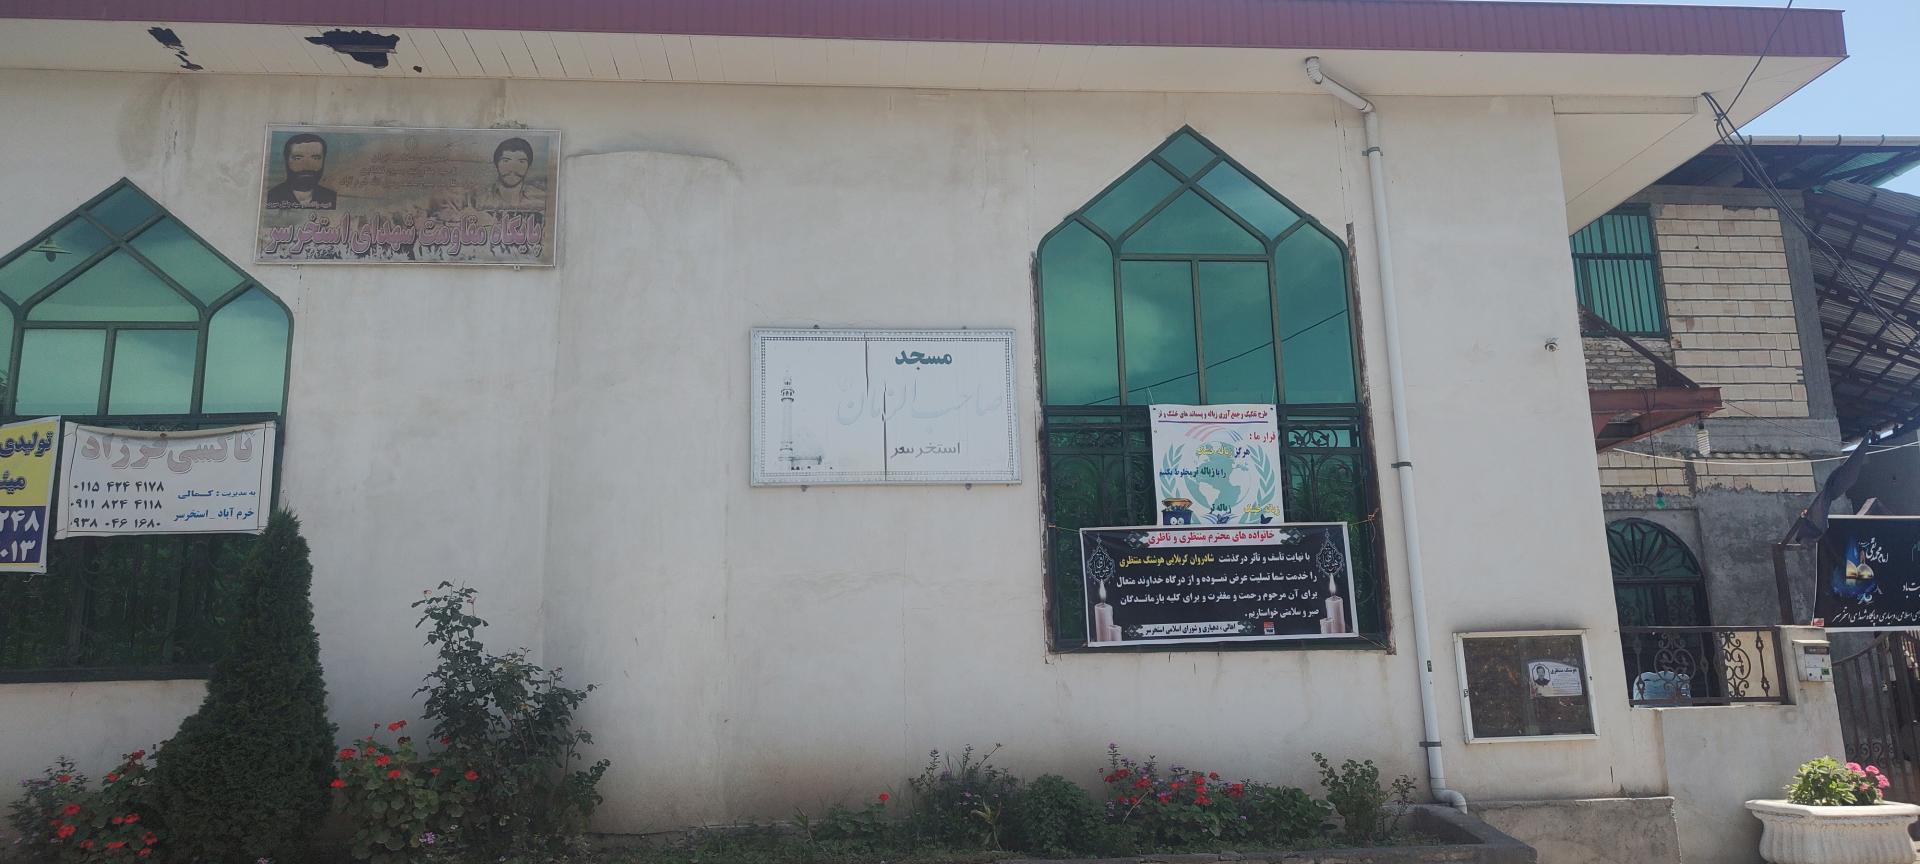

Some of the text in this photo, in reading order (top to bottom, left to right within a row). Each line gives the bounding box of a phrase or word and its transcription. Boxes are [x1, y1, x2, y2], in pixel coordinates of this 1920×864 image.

[264, 210, 545, 258] پایگاه مقاومت شهدای استخرسر
[895, 349, 953, 371] مسجد
[1254, 432, 1261, 440] ما
[1263, 432, 1276, 443] قرار
[0, 430, 54, 457] تولیدی
[1200, 466, 1216, 478] زباله
[1219, 467, 1226, 478] را
[74, 481, 164, 492] ۰۱۱۵ ۴۲۴ ۴۱۷۸
[177, 489, 214, 499] کمالی
[101, 500, 128, 510] ۸۲۴
[134, 499, 162, 510] ۴۱۱۸
[173, 509, 209, 521] استخرسر
[217, 508, 233, 517] آباد
[236, 509, 254, 519] خرم
[1147, 530, 1275, 545] خانواده های محترم منتظری و ناظری
[1166, 553, 1189, 566] کربلایی
[1189, 552, 1215, 566] شادروان
[1262, 556, 1267, 564] و
[1285, 553, 1304, 563] نهایت
[1305, 552, 1310, 560] با
[1119, 556, 1142, 568] منتظری
[1116, 576, 1136, 588] متعال
[1137, 575, 1164, 587] خداوند
[1187, 575, 1194, 586] از
[1195, 578, 1200, 586] و
[1229, 573, 1248, 585] عرض
[1249, 573, 1271, 583] تسلیت
[1271, 573, 1284, 581] شما
[1285, 572, 1309, 581] خدمت
[1309, 571, 1318, 582] را
[1166, 593, 1181, 604] کلیه
[1182, 593, 1200, 604] برای
[1207, 593, 1231, 603] مغفرت
[1238, 592, 1261, 601] رحمت
[1262, 592, 1287, 601] مرحوم
[1287, 588, 1299, 600] آن
[1300, 589, 1318, 600] برای
[1280, 608, 1301, 618] سلامتی
[1307, 608, 1319, 618] صبر
